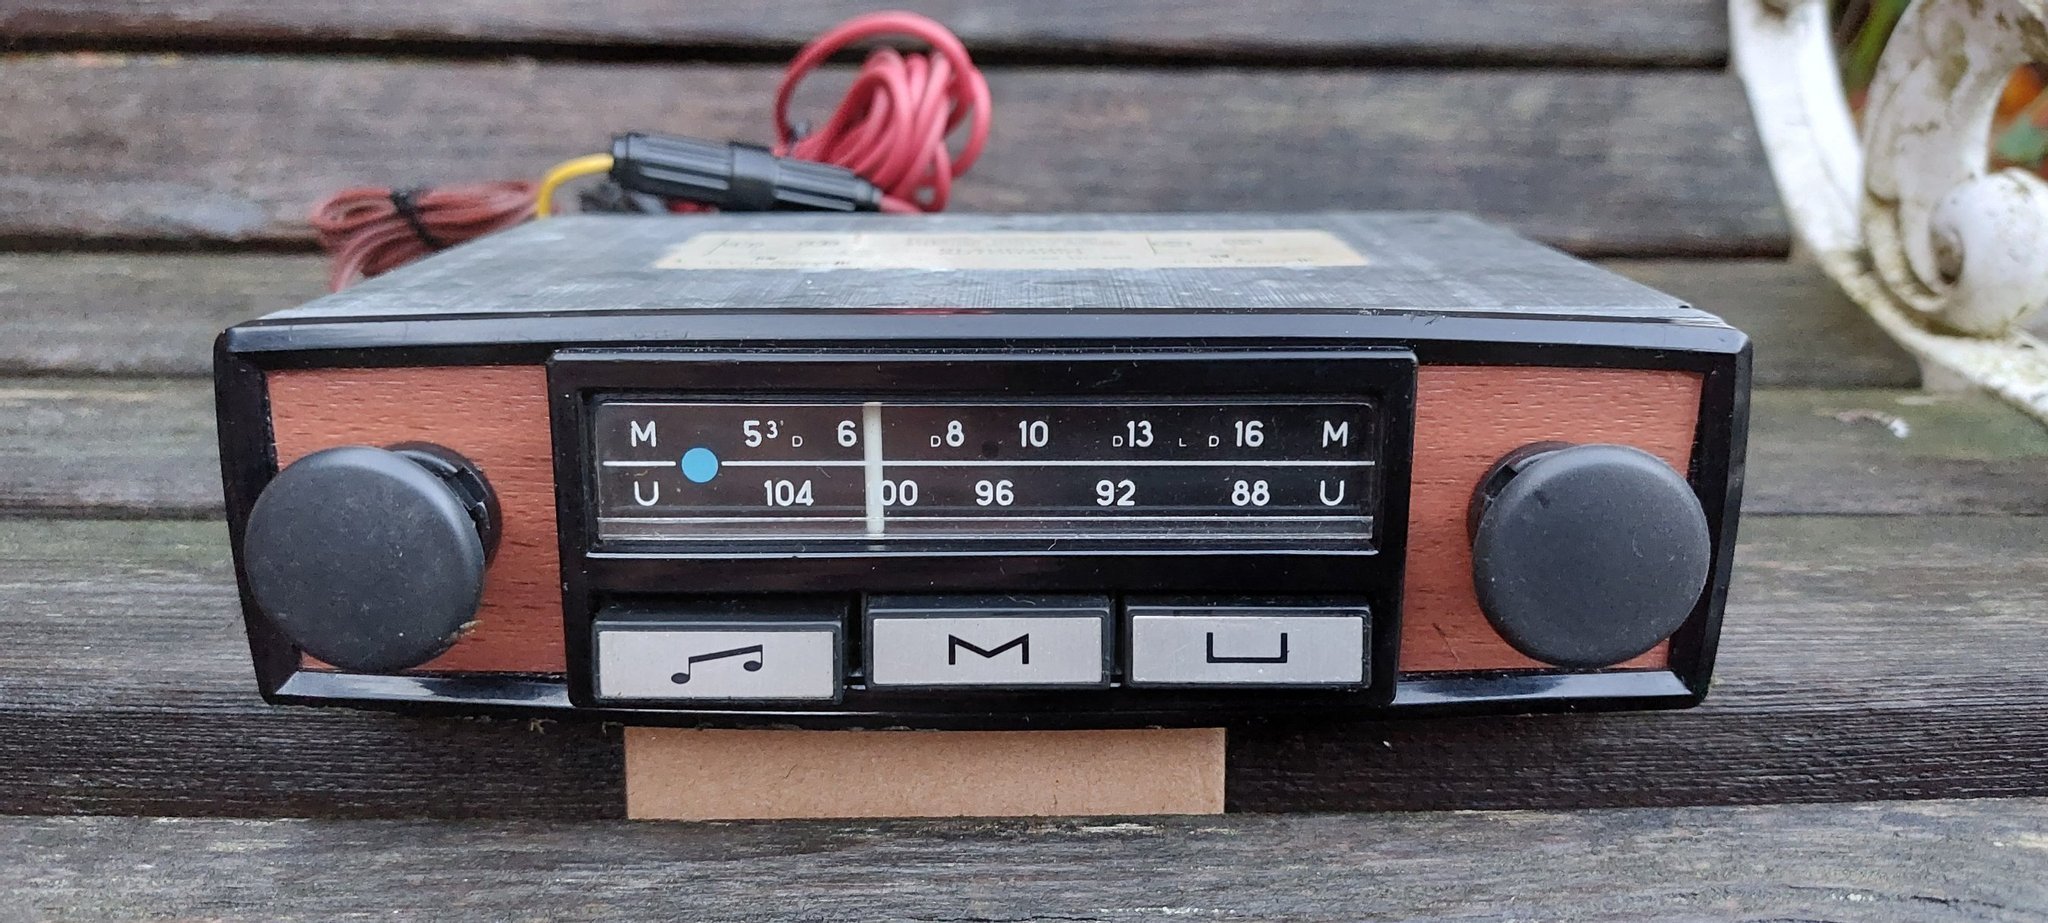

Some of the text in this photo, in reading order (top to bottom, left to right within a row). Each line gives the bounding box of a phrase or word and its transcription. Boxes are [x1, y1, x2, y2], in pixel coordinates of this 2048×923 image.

[630, 420, 657, 448] M
[791, 435, 804, 448] D
[837, 419, 857, 448] 6
[930, 435, 942, 448] D
[945, 420, 965, 448] 8
[1018, 420, 1049, 448] 10
[1112, 435, 1124, 448] D
[1126, 420, 1154, 448] 13
[1208, 435, 1220, 448] D
[1234, 420, 1264, 448] 16
[1322, 420, 1349, 448] M
[633, 478, 1345, 507] U 104 00 96 92 88 U
[948, 633, 1030, 666] M
